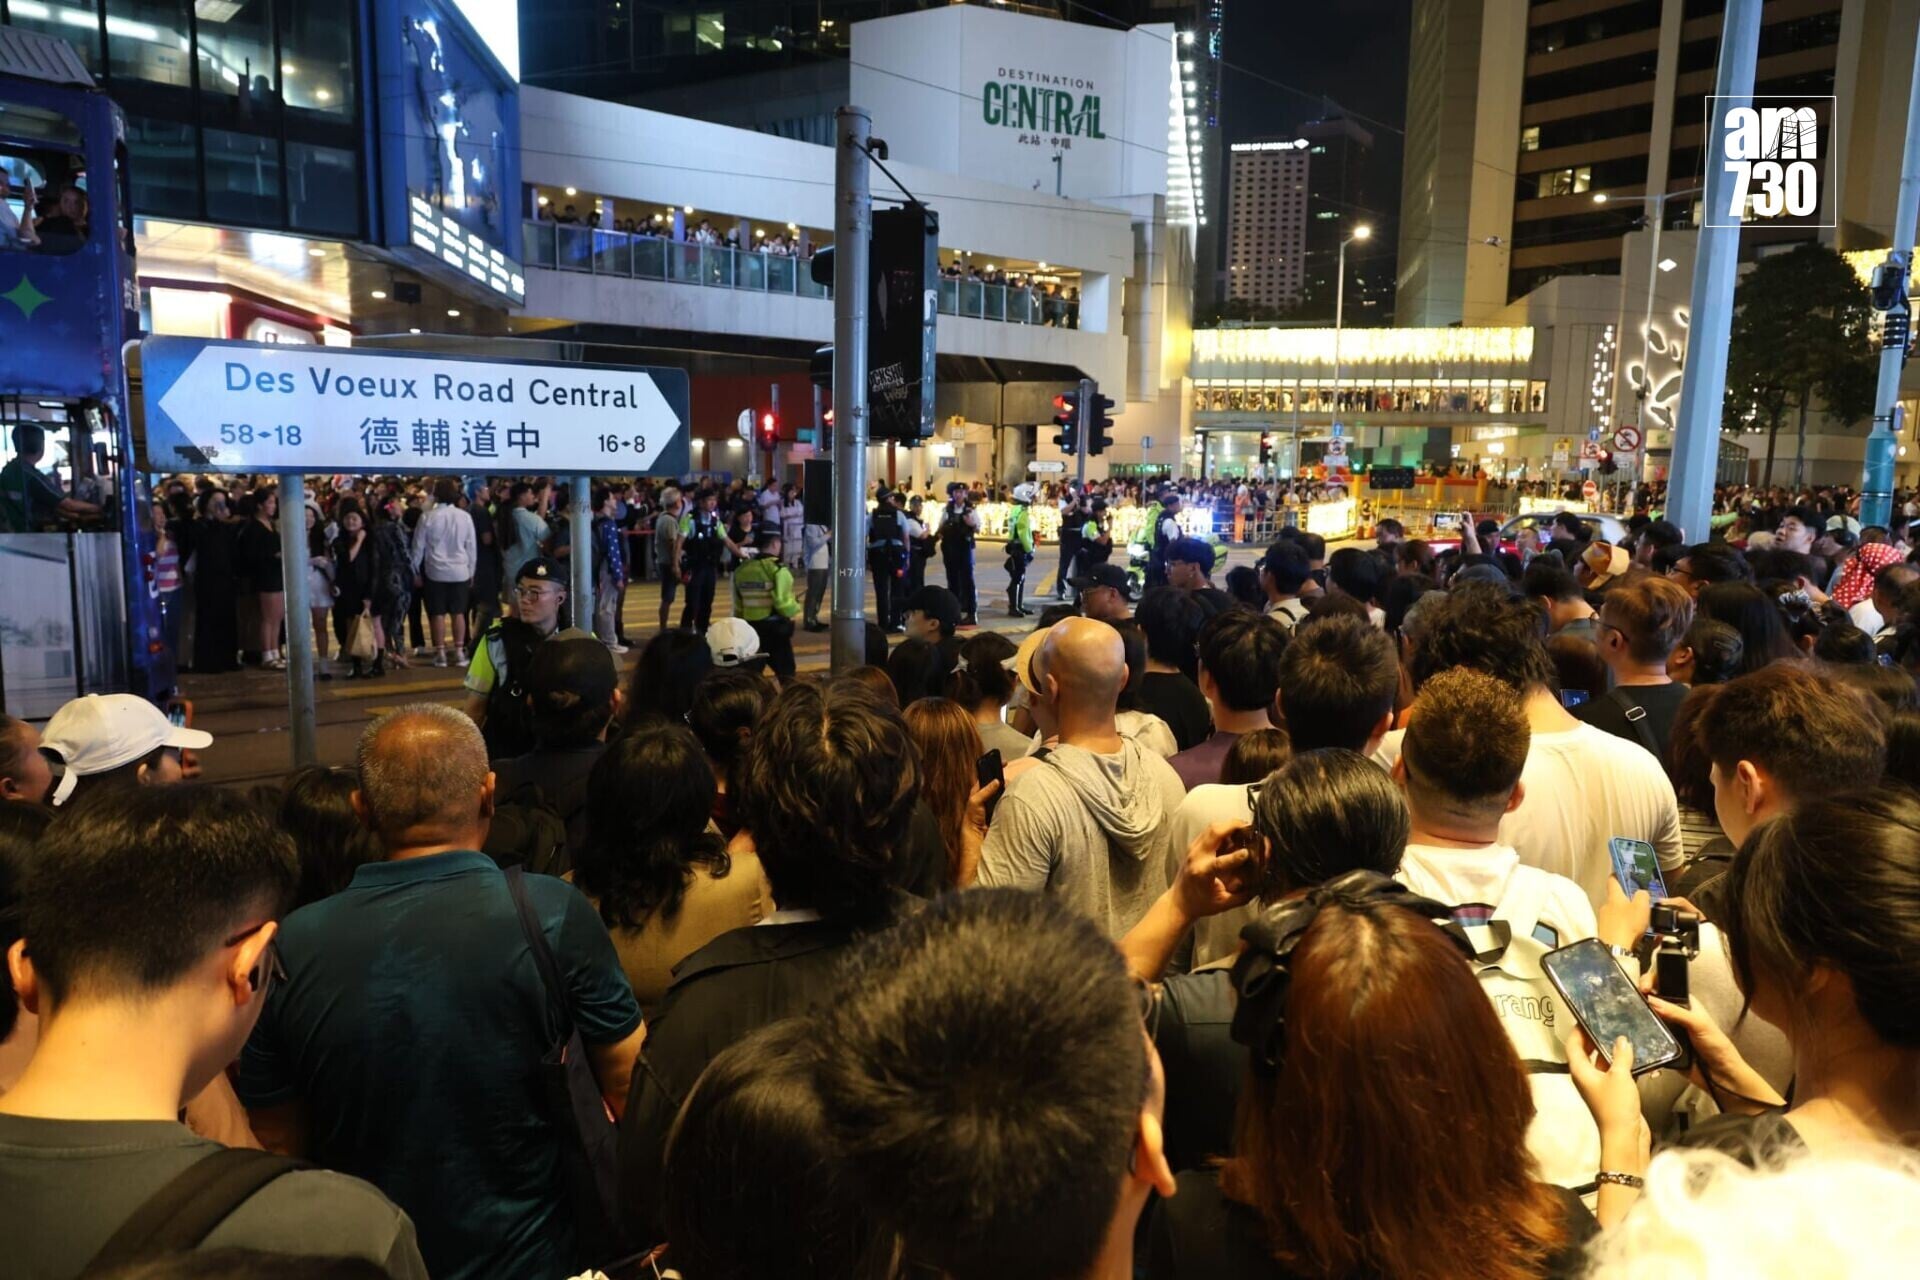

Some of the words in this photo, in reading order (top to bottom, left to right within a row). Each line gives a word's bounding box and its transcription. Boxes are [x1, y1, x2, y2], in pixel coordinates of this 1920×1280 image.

[998, 67, 1094, 90] DESTINATION
[983, 81, 1106, 139] CENTRAL
[225, 362, 295, 394] Des
[308, 367, 418, 399] Voeux
[434, 374, 514, 403] Road
[529, 379, 638, 409] Central
[220, 423, 253, 445] 58
[275, 425, 302, 447] 18
[360, 416, 540, 459] 德輔道中
[598, 434, 619, 453] 16
[634, 435, 646, 453] 8
